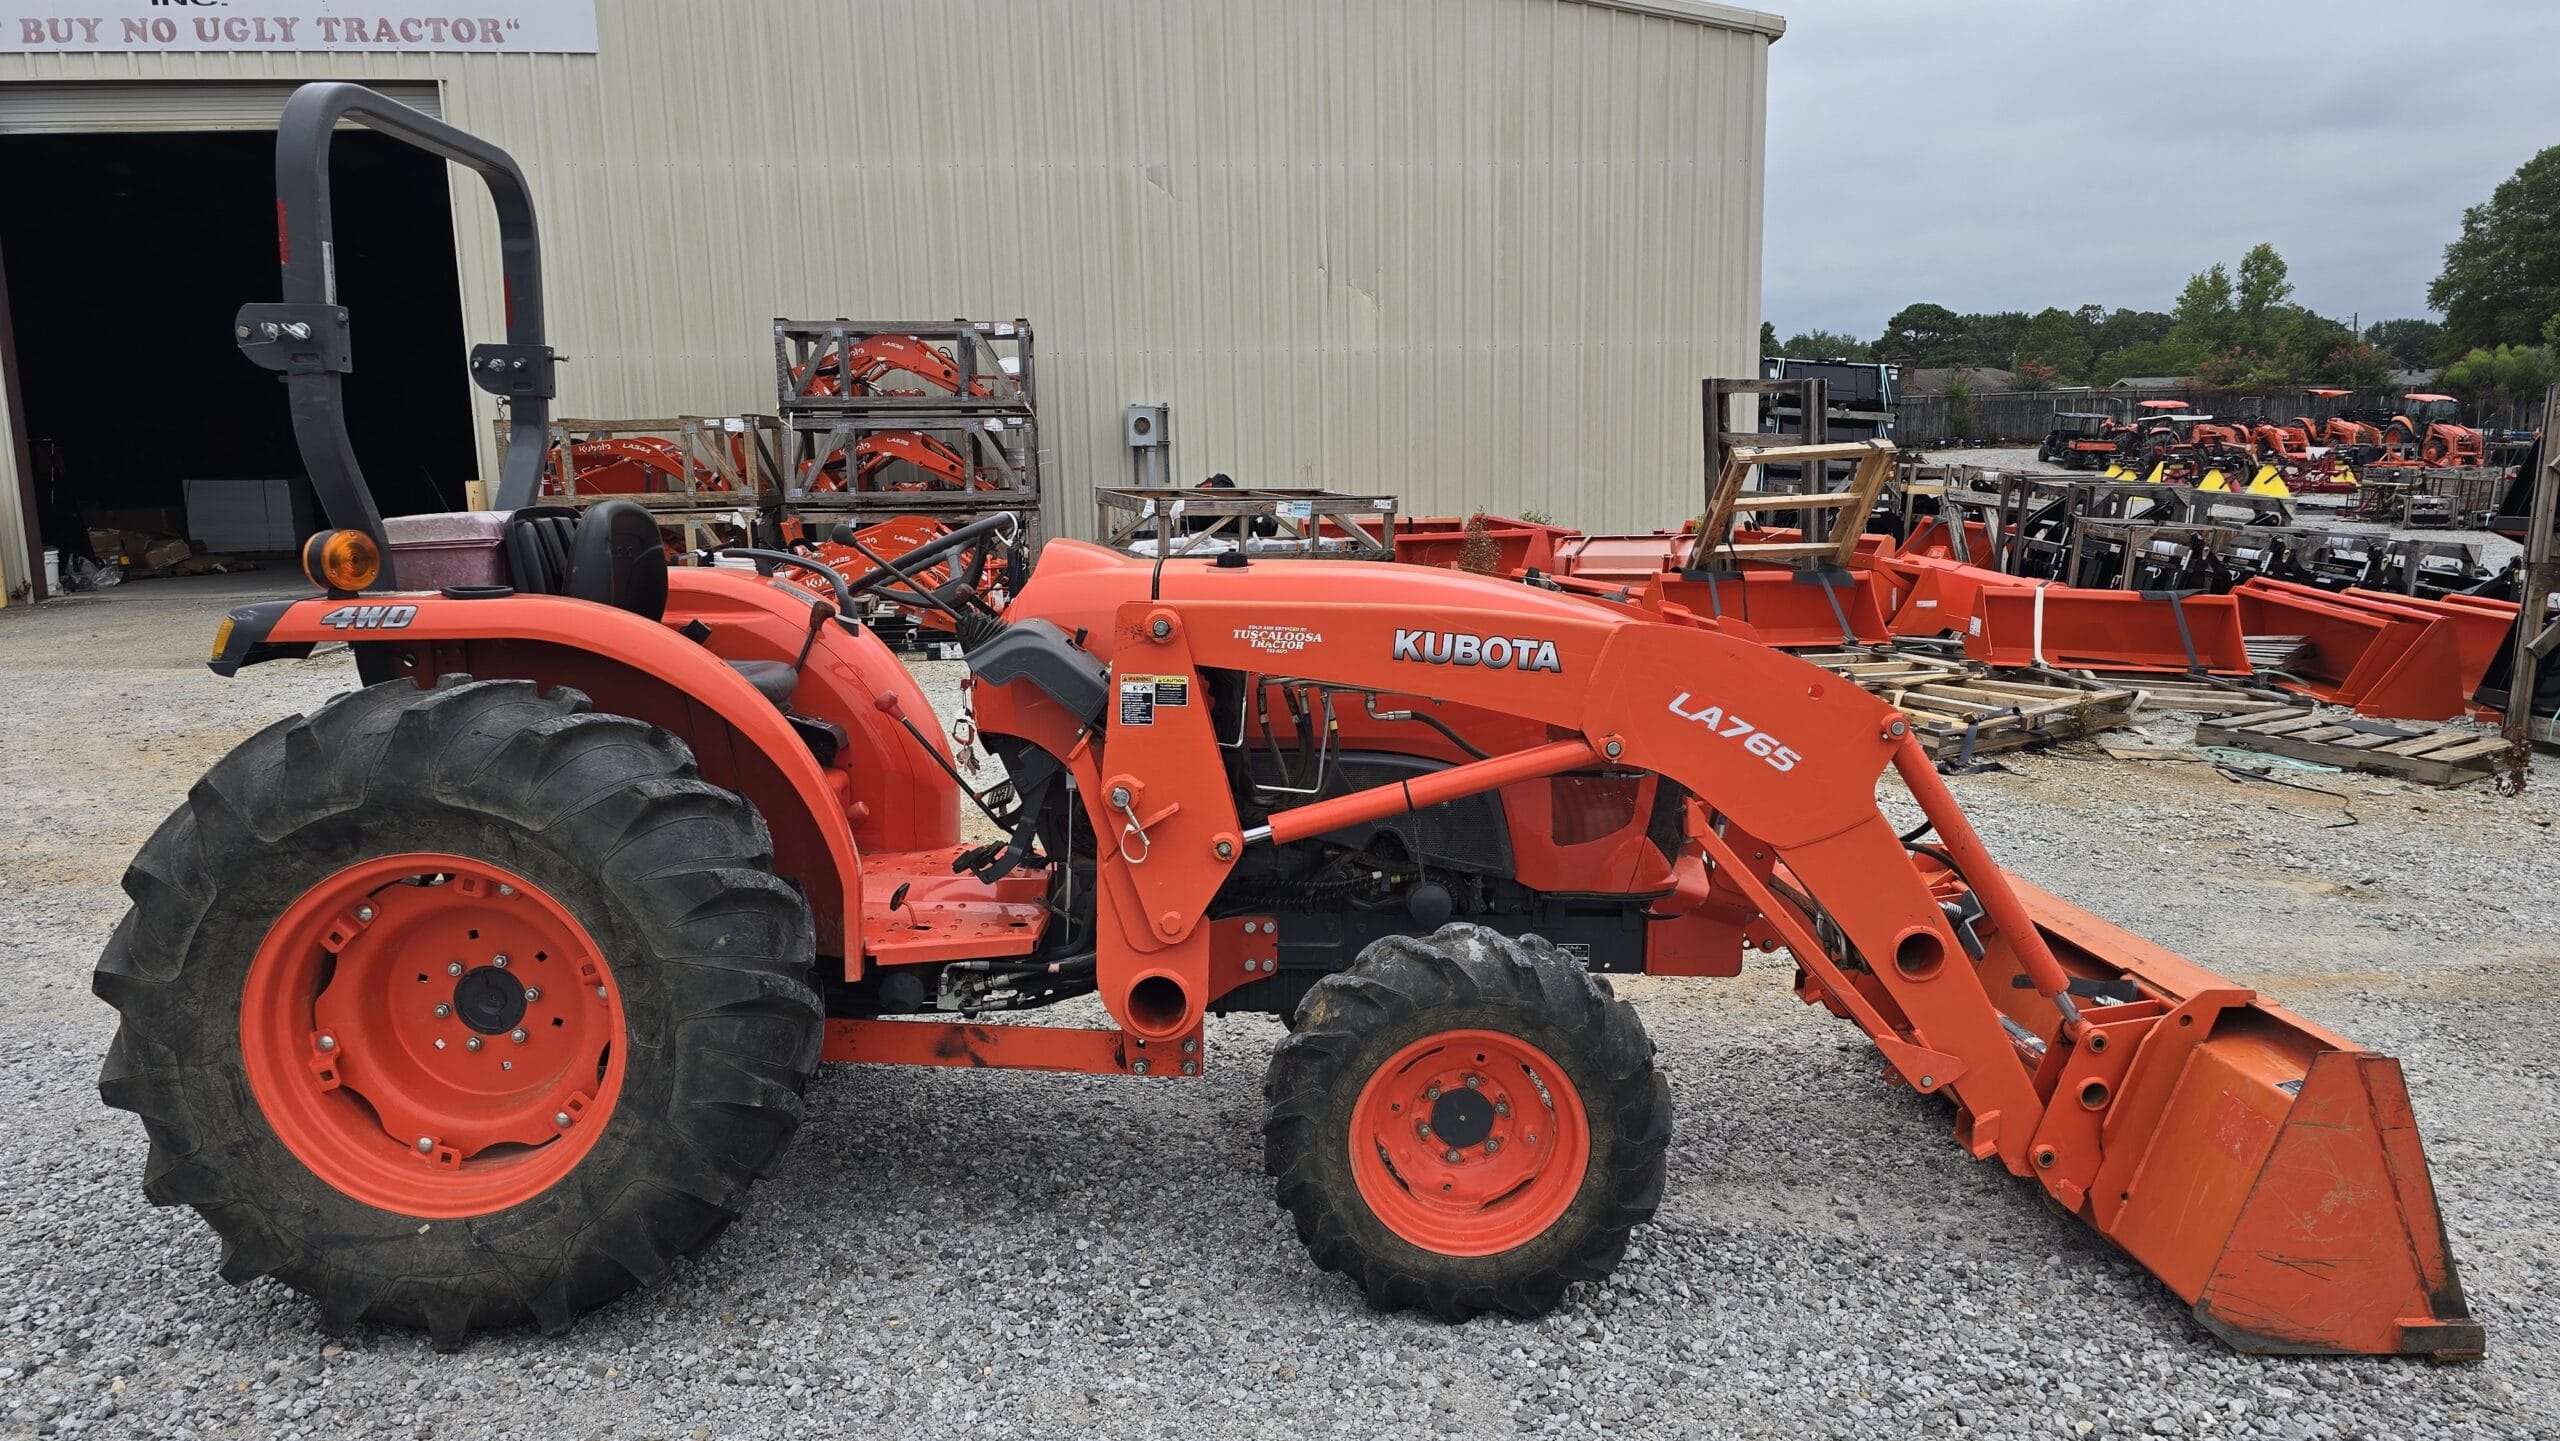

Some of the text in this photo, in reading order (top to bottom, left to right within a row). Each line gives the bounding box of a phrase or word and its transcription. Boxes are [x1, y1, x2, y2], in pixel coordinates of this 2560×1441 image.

[18, 17, 103, 44] BUY
[120, 17, 177, 43] NO
[192, 16, 300, 43] UGLY
[578, 442, 612, 453] Kubota
[320, 604, 419, 630] 4WD
[1232, 629, 1323, 643] TUSCALOOSA
[1250, 638, 1305, 650] TRACTOR
[1392, 628, 1562, 674] KUBOTA
[1667, 691, 1803, 773] LA765
